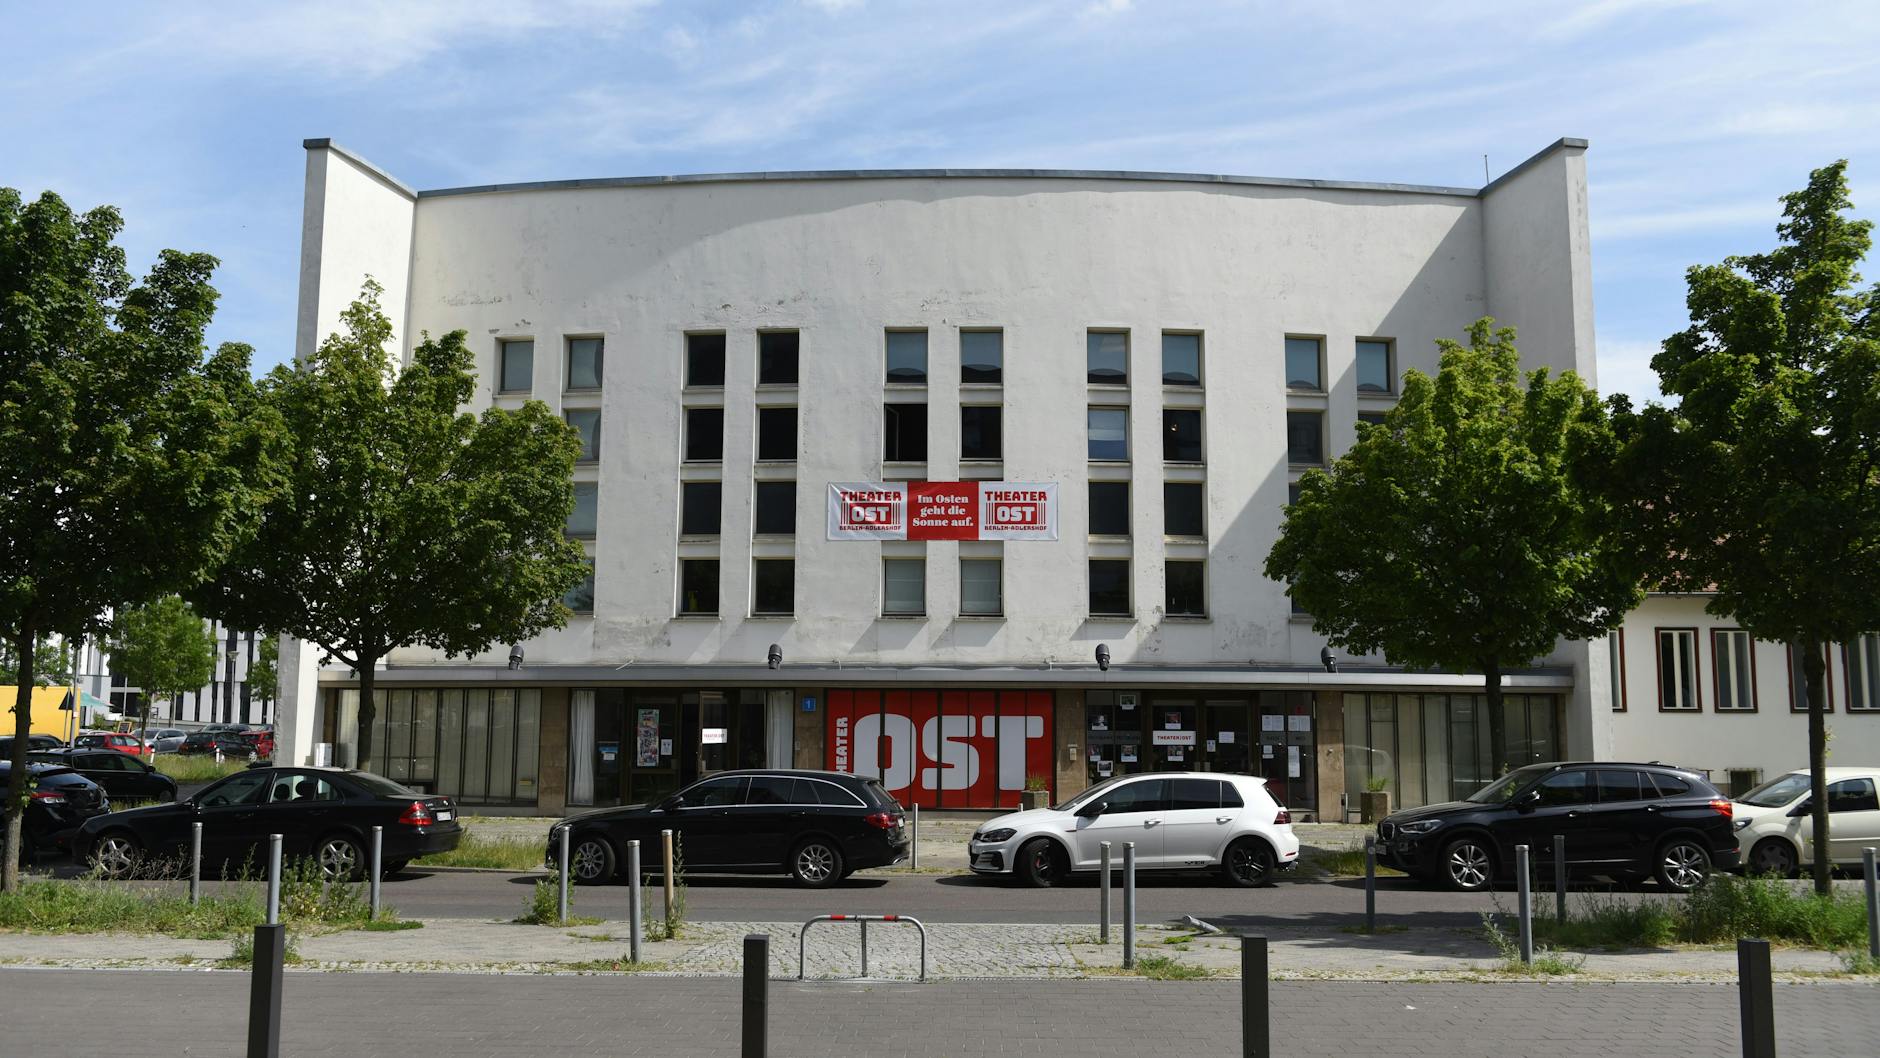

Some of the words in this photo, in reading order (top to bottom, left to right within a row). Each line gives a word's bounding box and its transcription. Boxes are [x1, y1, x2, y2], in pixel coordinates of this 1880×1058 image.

[840, 491, 902, 502] THEATER
[917, 495, 933, 504] Im
[935, 494, 969, 504] Osten
[984, 491, 1047, 501] THEATER
[851, 506, 890, 522] OST
[920, 505, 945, 518] geht
[947, 505, 966, 515] die
[996, 506, 1035, 522] OST
[912, 517, 949, 527] Sonne
[951, 516, 974, 527] auf.
[805, 700, 811, 709] 1
[836, 717, 848, 773] HEATER
[854, 713, 1044, 790] OST
